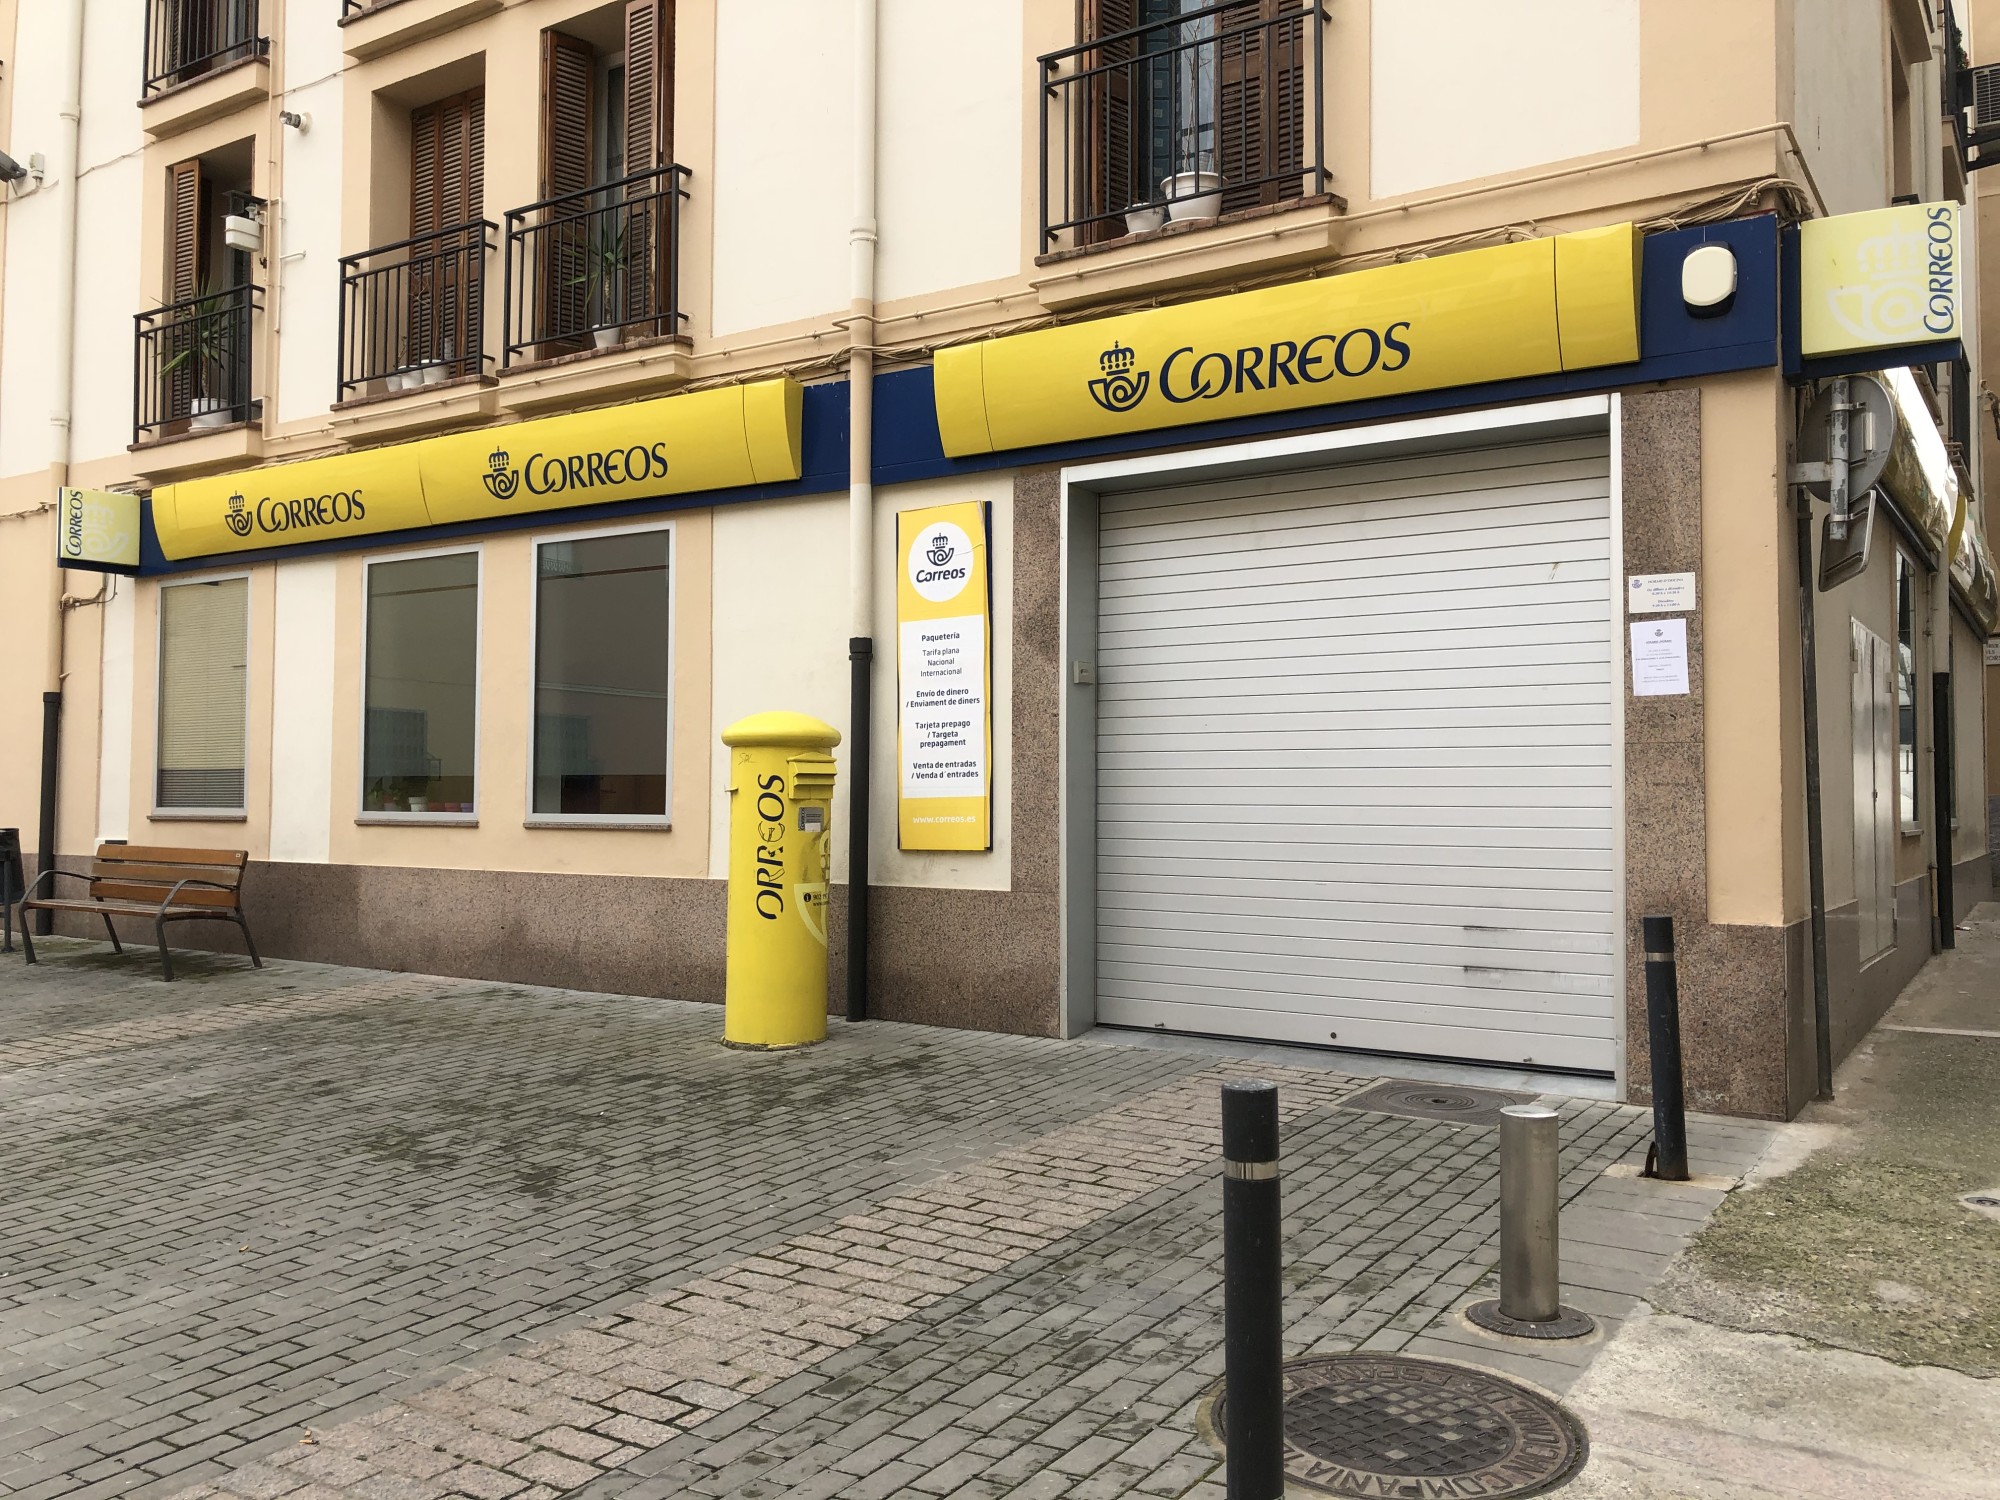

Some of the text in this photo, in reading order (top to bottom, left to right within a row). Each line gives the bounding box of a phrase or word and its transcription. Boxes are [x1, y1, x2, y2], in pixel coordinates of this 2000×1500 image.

[1924, 207, 1955, 334] CORREOS
[1159, 321, 1411, 404] CORREOS
[524, 442, 669, 495] CORREOS
[256, 489, 366, 533] CORREOS
[65, 489, 84, 557] CORREOS
[916, 567, 966, 583] Correos
[921, 632, 960, 642] Paquetería
[922, 647, 960, 657] Tarifa plana
[927, 657, 955, 666] Nacional
[920, 667, 962, 677] Internacional
[936, 689, 945, 697] de
[946, 688, 969, 696] dinero
[910, 699, 947, 708] Enviament
[948, 698, 957, 706] de
[957, 697, 980, 705] diners
[915, 720, 971, 730] Tarjeta prepago
[932, 730, 959, 739] Targeta
[919, 739, 966, 749] prepagament
[945, 760, 977, 768] entradas
[915, 771, 938, 779] Venda
[912, 815, 976, 824] www.correos.es
